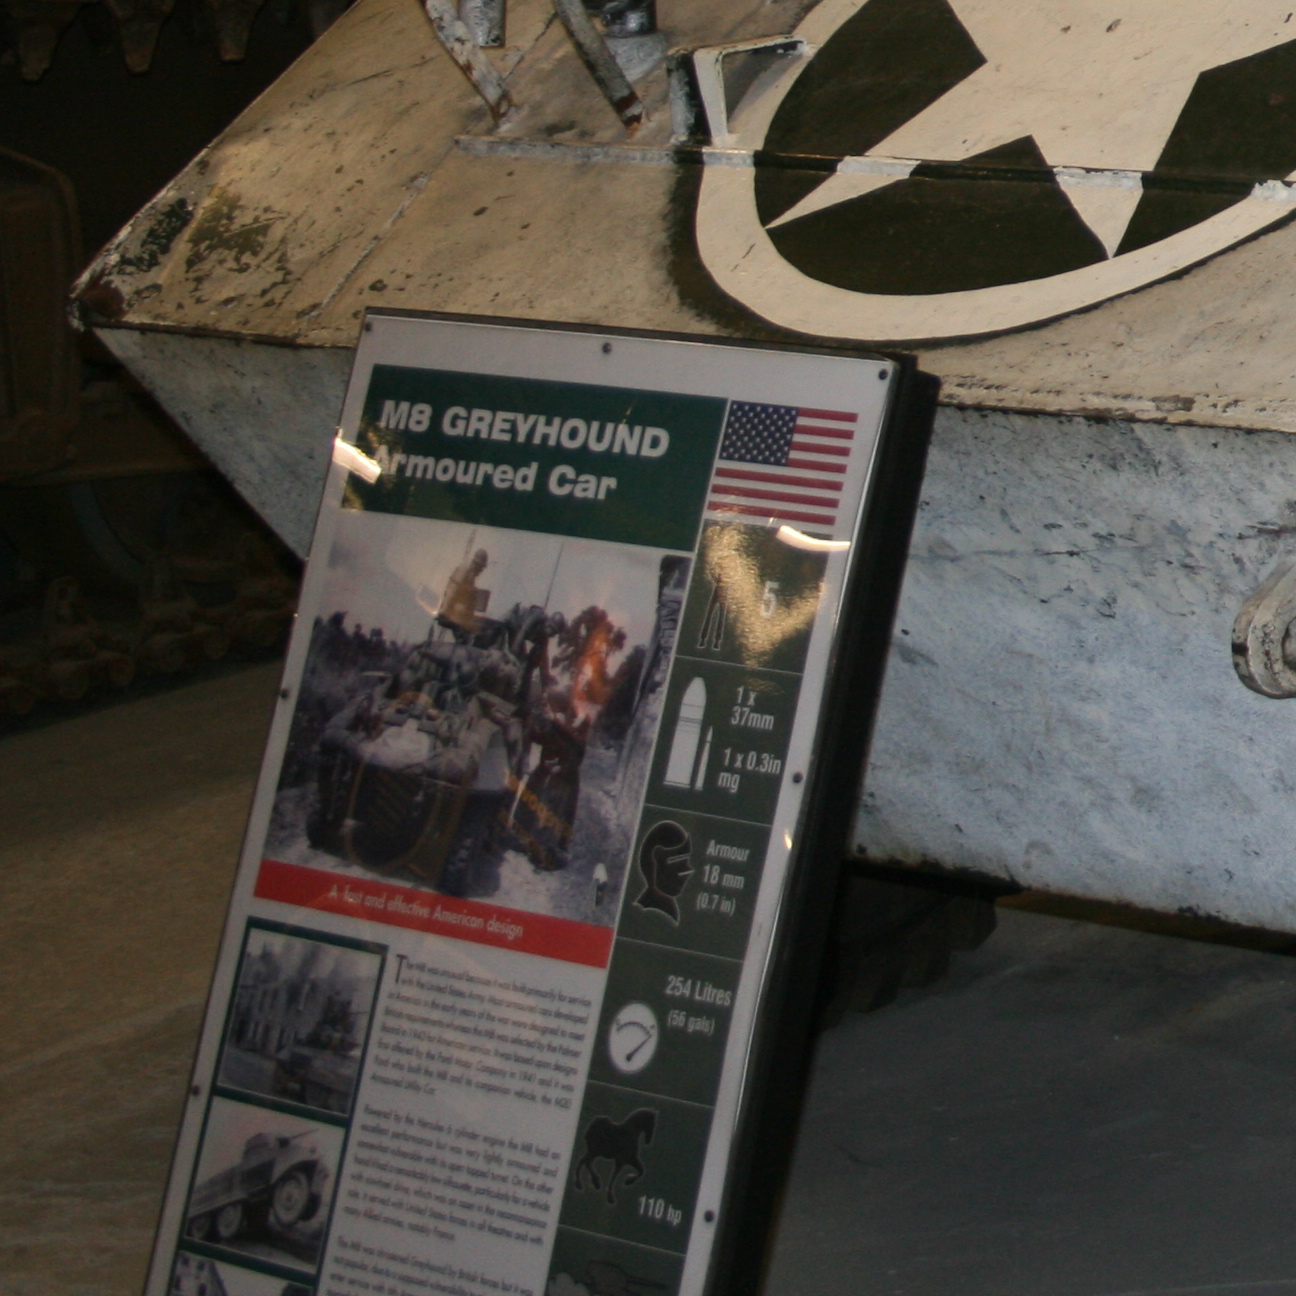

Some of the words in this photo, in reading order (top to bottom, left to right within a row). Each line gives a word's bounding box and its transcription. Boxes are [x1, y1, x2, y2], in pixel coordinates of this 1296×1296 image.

[379, 399, 433, 433] M8
[441, 405, 671, 458] GREYHOUND
[372, 444, 539, 492] Armoured
[549, 465, 618, 500] Car
[760, 581, 780, 618] 5
[736, 686, 745, 704] 1
[731, 706, 774, 731] 37mm
[724, 748, 732, 766] 1
[735, 754, 745, 769] x
[747, 751, 781, 775] 0.3in
[718, 772, 740, 794] mg
[706, 840, 750, 861] Armour
[703, 865, 719, 885] 18
[723, 873, 745, 890] mm
[327, 884, 339, 899] A
[344, 885, 364, 906] fast
[365, 892, 387, 910] and
[388, 894, 431, 919] effective
[433, 906, 485, 931] American
[486, 915, 524, 941] design
[697, 893, 717, 913] (0.7
[666, 976, 691, 997] 254
[695, 981, 732, 1007] Litres
[668, 1010, 684, 1030] (56
[687, 1016, 715, 1036] gals)
[639, 1195, 664, 1220] 110
[667, 1206, 682, 1228] hp
